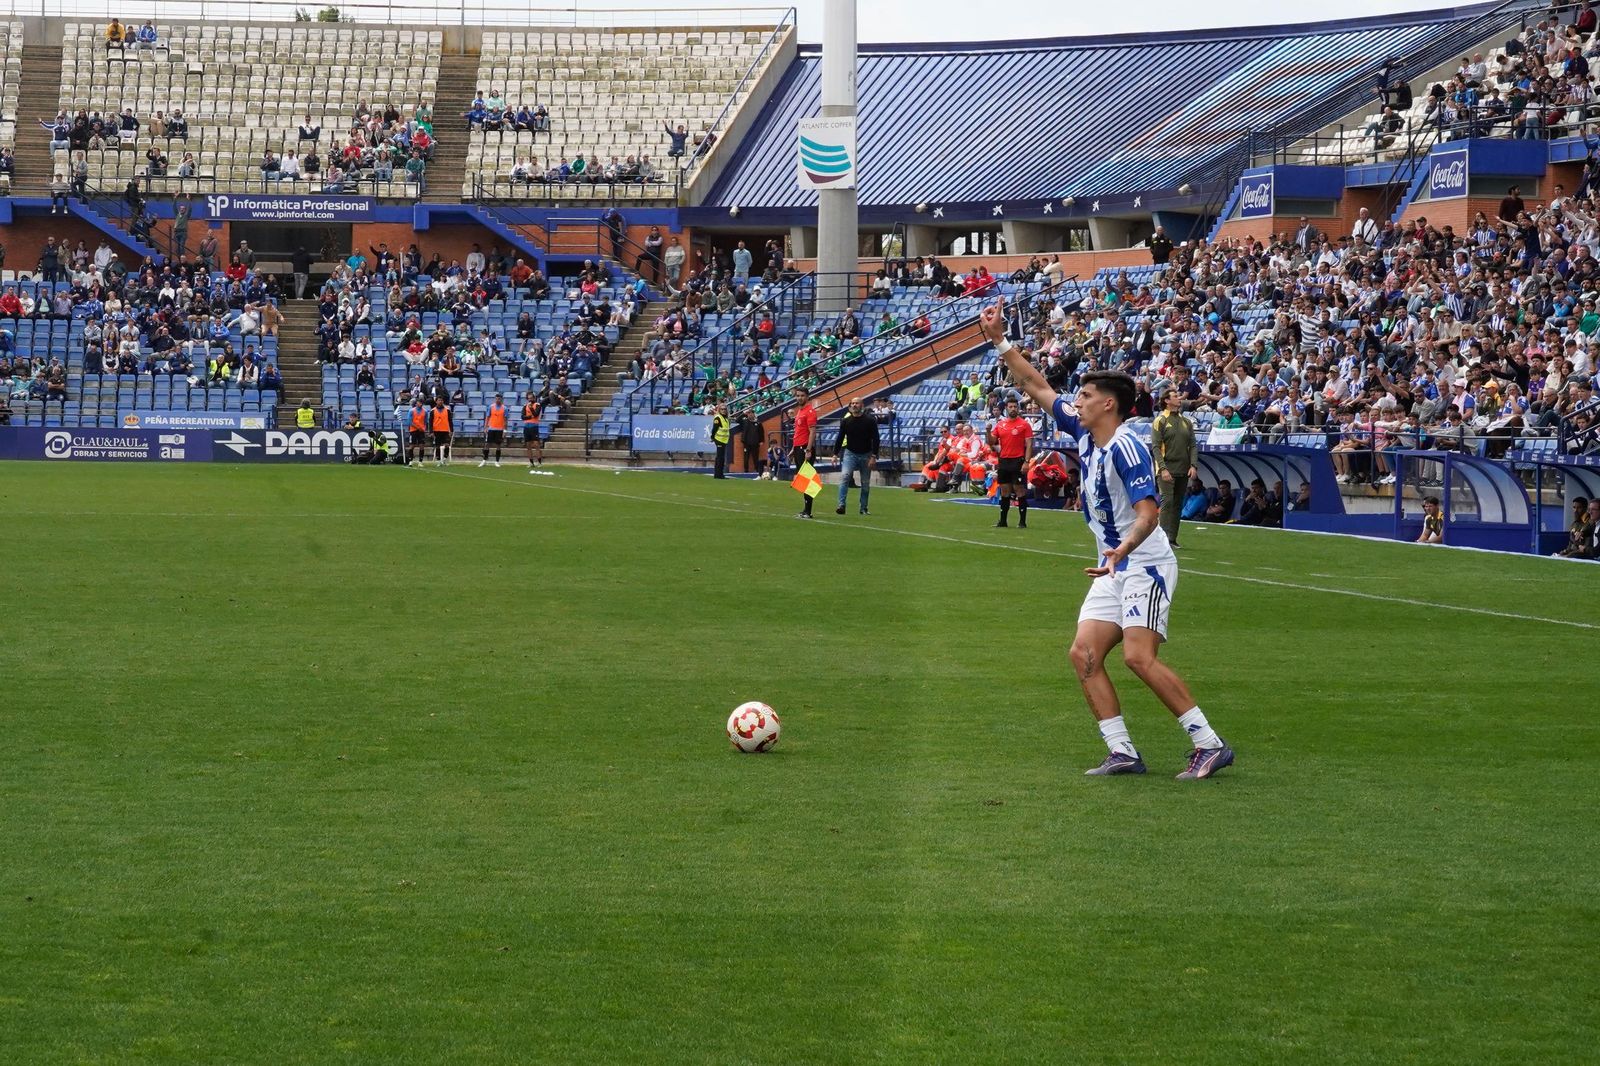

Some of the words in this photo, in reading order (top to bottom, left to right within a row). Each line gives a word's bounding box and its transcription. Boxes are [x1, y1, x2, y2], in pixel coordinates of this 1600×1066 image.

[801, 122, 828, 130] ATLANTIC
[830, 121, 852, 129] COPPER
[302, 199, 369, 211] Profesional
[251, 210, 335, 219] www.ipinfortel.com
[145, 415, 168, 425] PEÑA
[169, 417, 235, 426] RECREATIVISTA
[633, 427, 660, 439] Grada
[662, 427, 695, 439] solidaria
